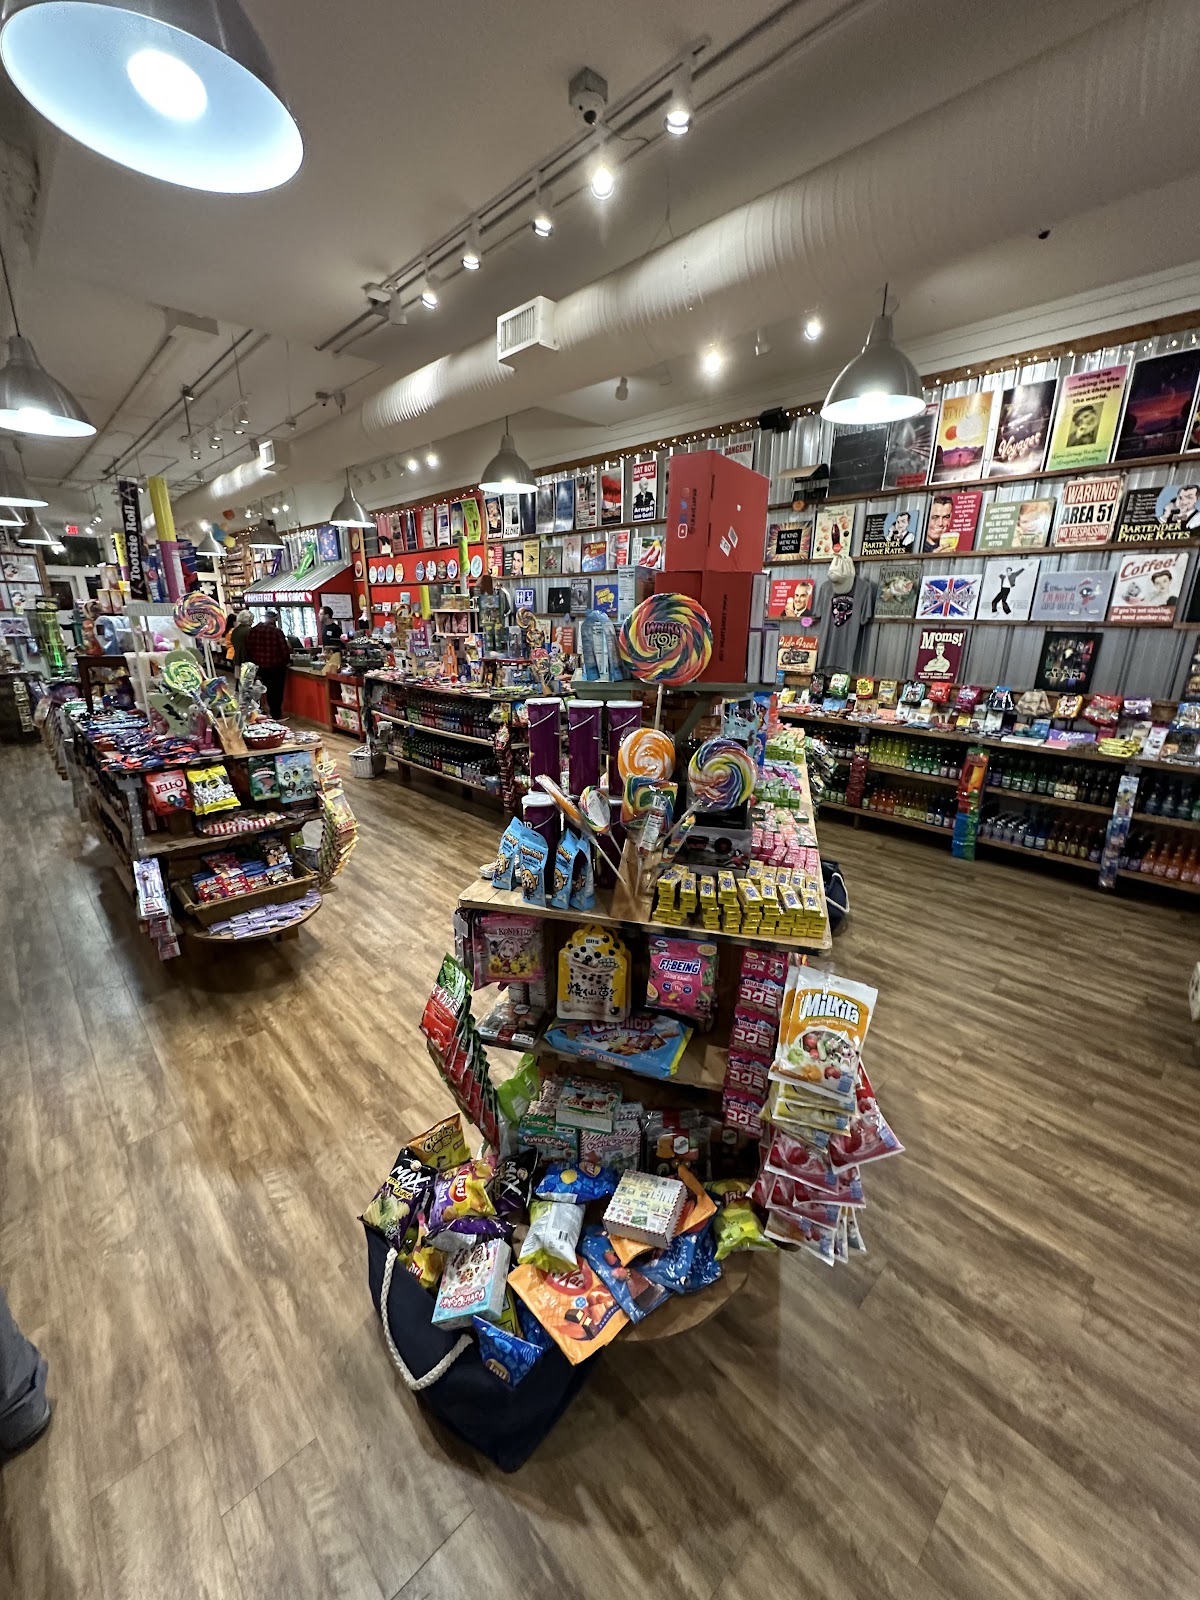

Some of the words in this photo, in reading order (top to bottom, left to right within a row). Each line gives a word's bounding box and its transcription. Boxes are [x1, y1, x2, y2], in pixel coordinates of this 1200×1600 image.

[1067, 481, 1118, 504] WARNING
[124, 504, 137, 531] Roll
[1061, 505, 1094, 525] AREA
[1096, 503, 1114, 522] 51
[1059, 527, 1068, 537] NO
[1069, 524, 1108, 538] TRESPASSING
[1118, 532, 1154, 542] PHONE
[1155, 531, 1190, 541] RATES
[1119, 523, 1181, 534] BARTENDER
[862, 541, 900, 549] BARTENDER
[884, 546, 905, 555] RATES
[128, 534, 141, 581] Tootsie
[1120, 553, 1179, 579] Coffee!
[779, 636, 795, 648] Ride
[796, 636, 818, 649] Free!
[920, 632, 964, 650] Moms!
[740, 988, 777, 1008] コグミ
[734, 1027, 771, 1048] コグミ
[729, 1069, 764, 1090] コグミ
[727, 1109, 762, 1128] コグミ
[423, 1123, 455, 1154] Cheetos
[391, 1166, 431, 1193] MAX
